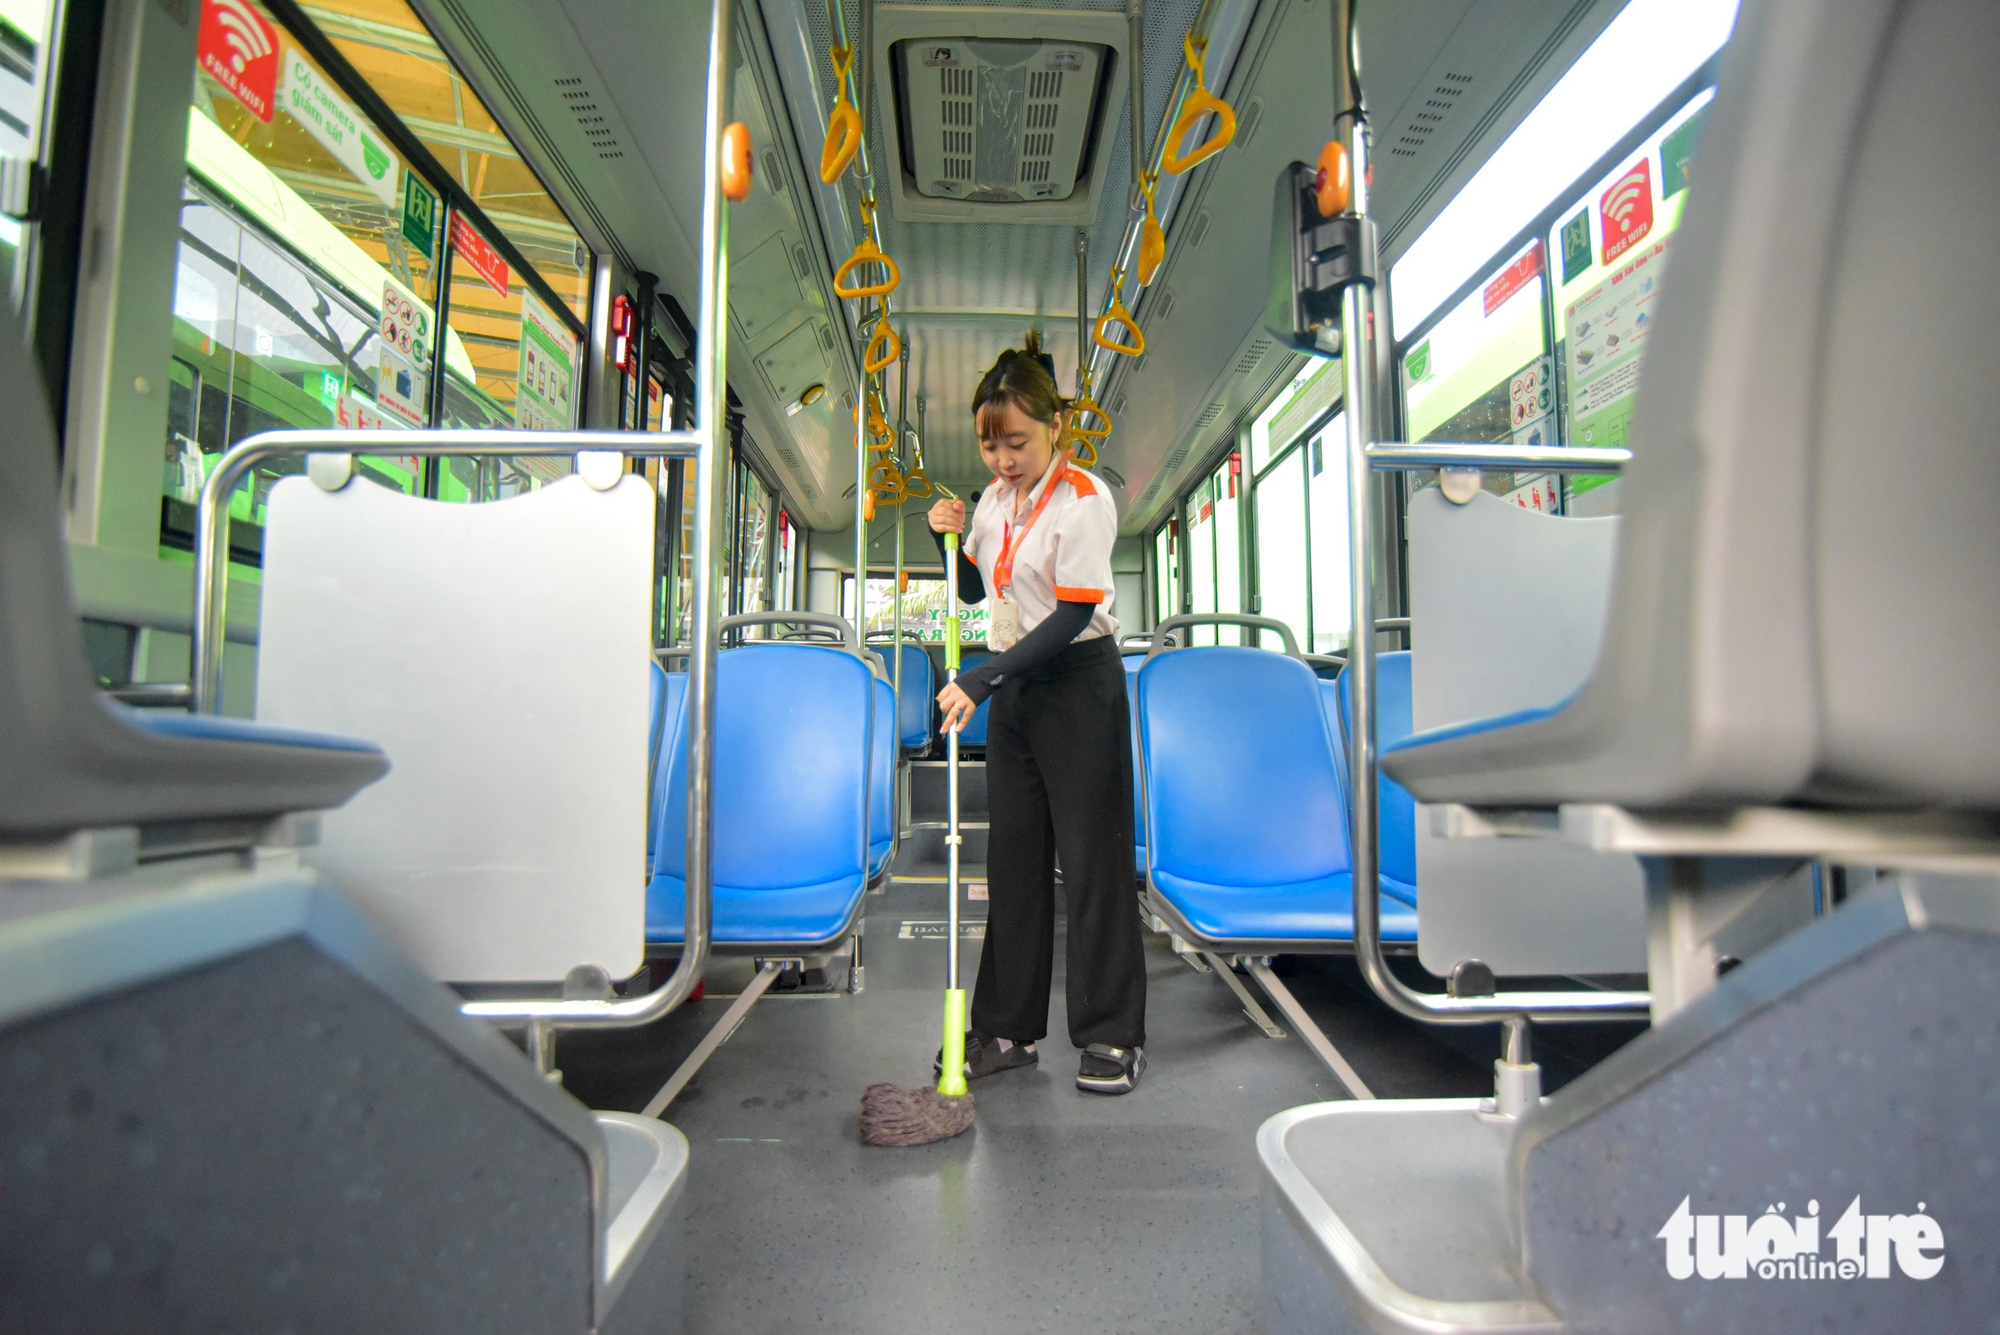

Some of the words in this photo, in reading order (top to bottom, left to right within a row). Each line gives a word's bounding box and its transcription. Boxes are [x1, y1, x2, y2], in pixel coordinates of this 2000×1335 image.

[206, 53, 237, 90] FREE
[239, 82, 265, 115] WIFI
[294, 61, 312, 89] Có
[313, 84, 356, 136] camera
[292, 88, 323, 126] giám
[325, 119, 344, 147] sát
[1606, 239, 1627, 261] FREE
[1627, 222, 1648, 244] WIFI
